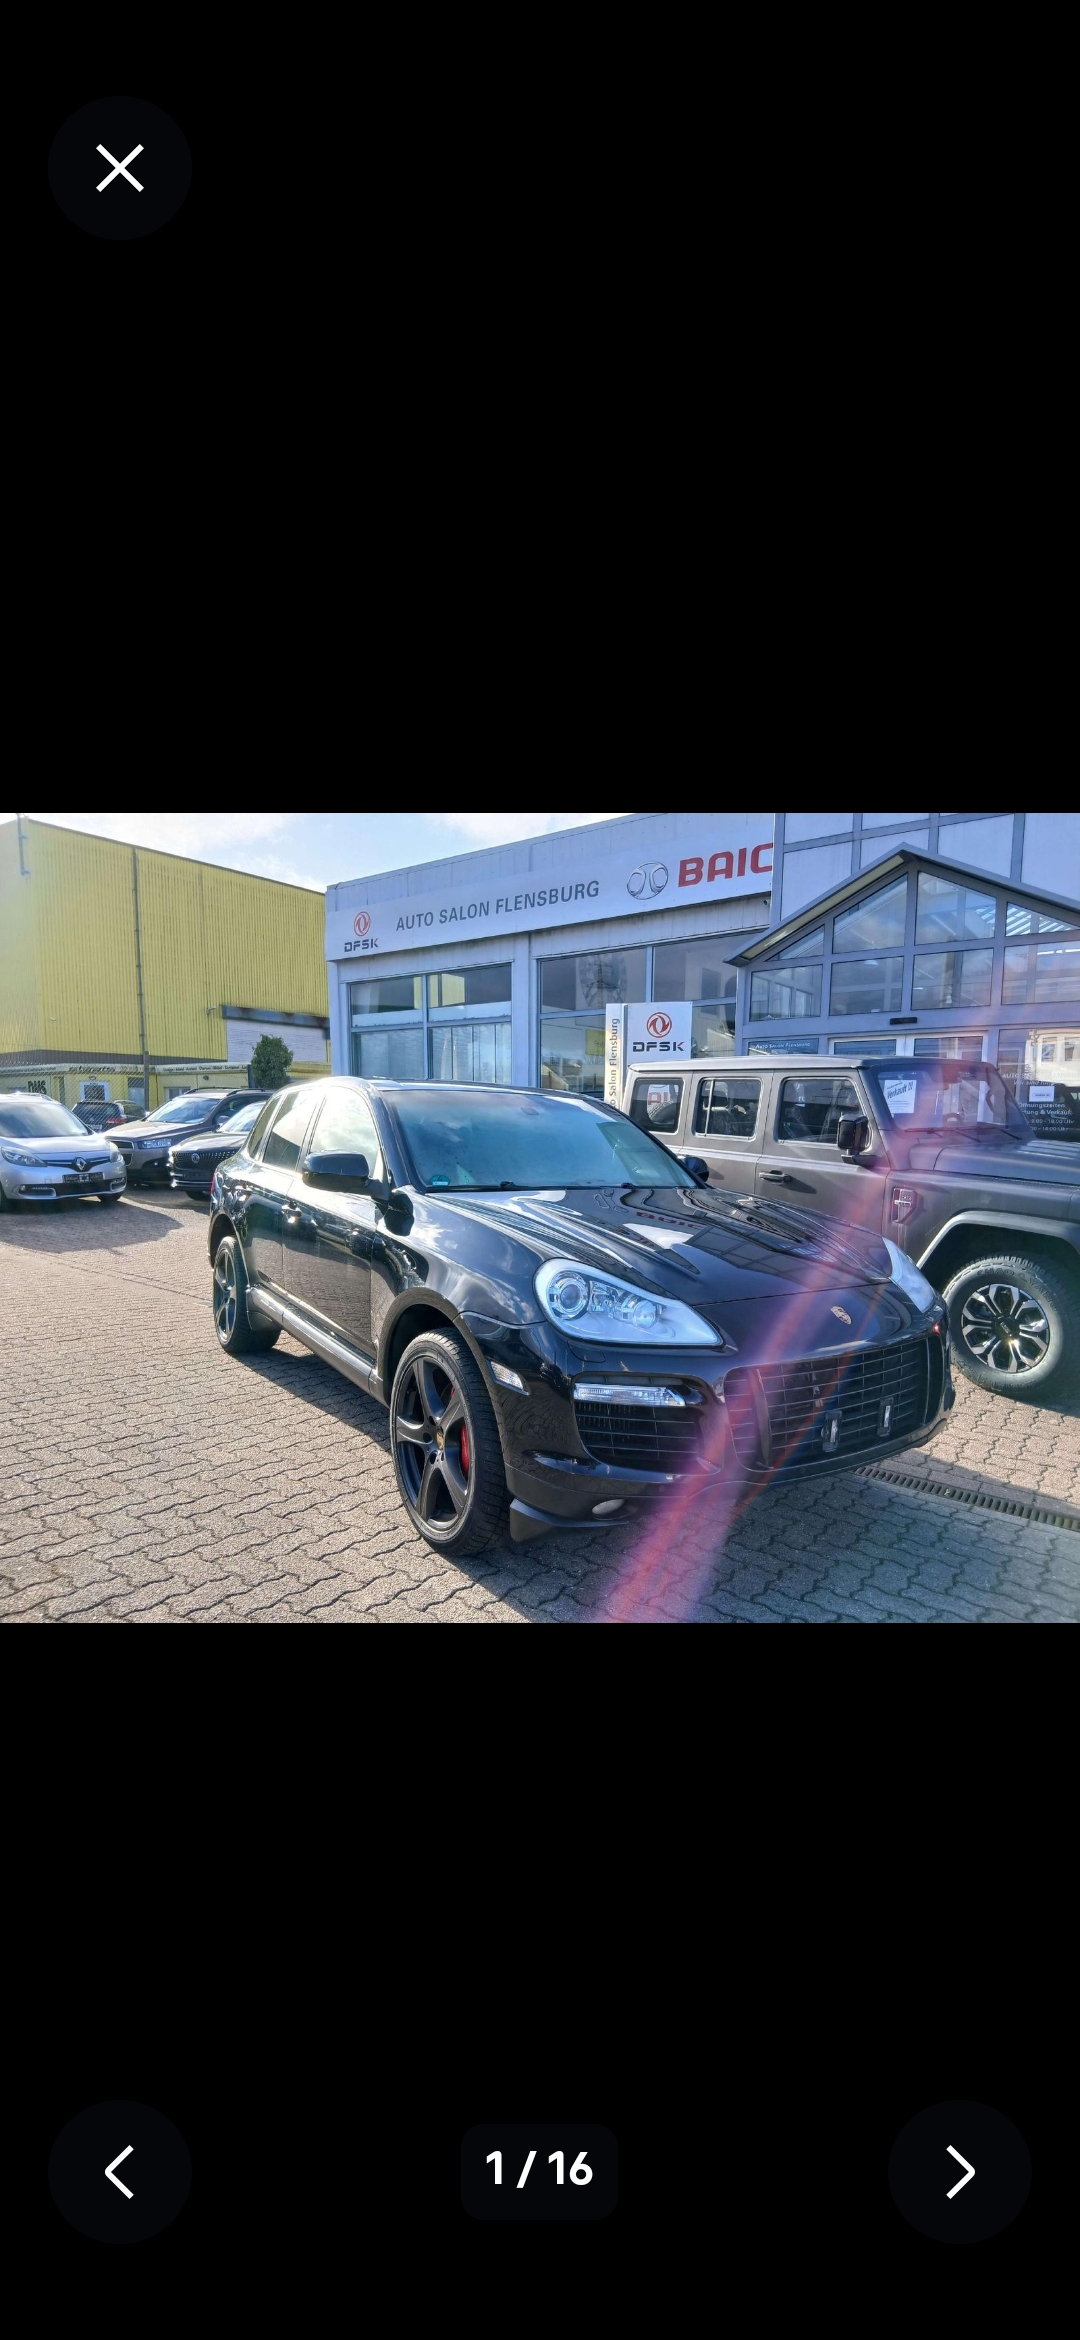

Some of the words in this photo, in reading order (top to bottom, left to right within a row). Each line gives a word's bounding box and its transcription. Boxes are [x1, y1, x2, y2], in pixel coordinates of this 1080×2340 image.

[678, 843, 774, 888] BAIC
[396, 911, 434, 932] AUTO
[439, 901, 490, 924] SALON
[495, 880, 600, 915] FLENSBURG
[344, 938, 379, 953] DFSK
[608, 1018, 621, 1067] Flensburg
[633, 1041, 685, 1053] DFSK
[608, 1069, 617, 1097] Salon
